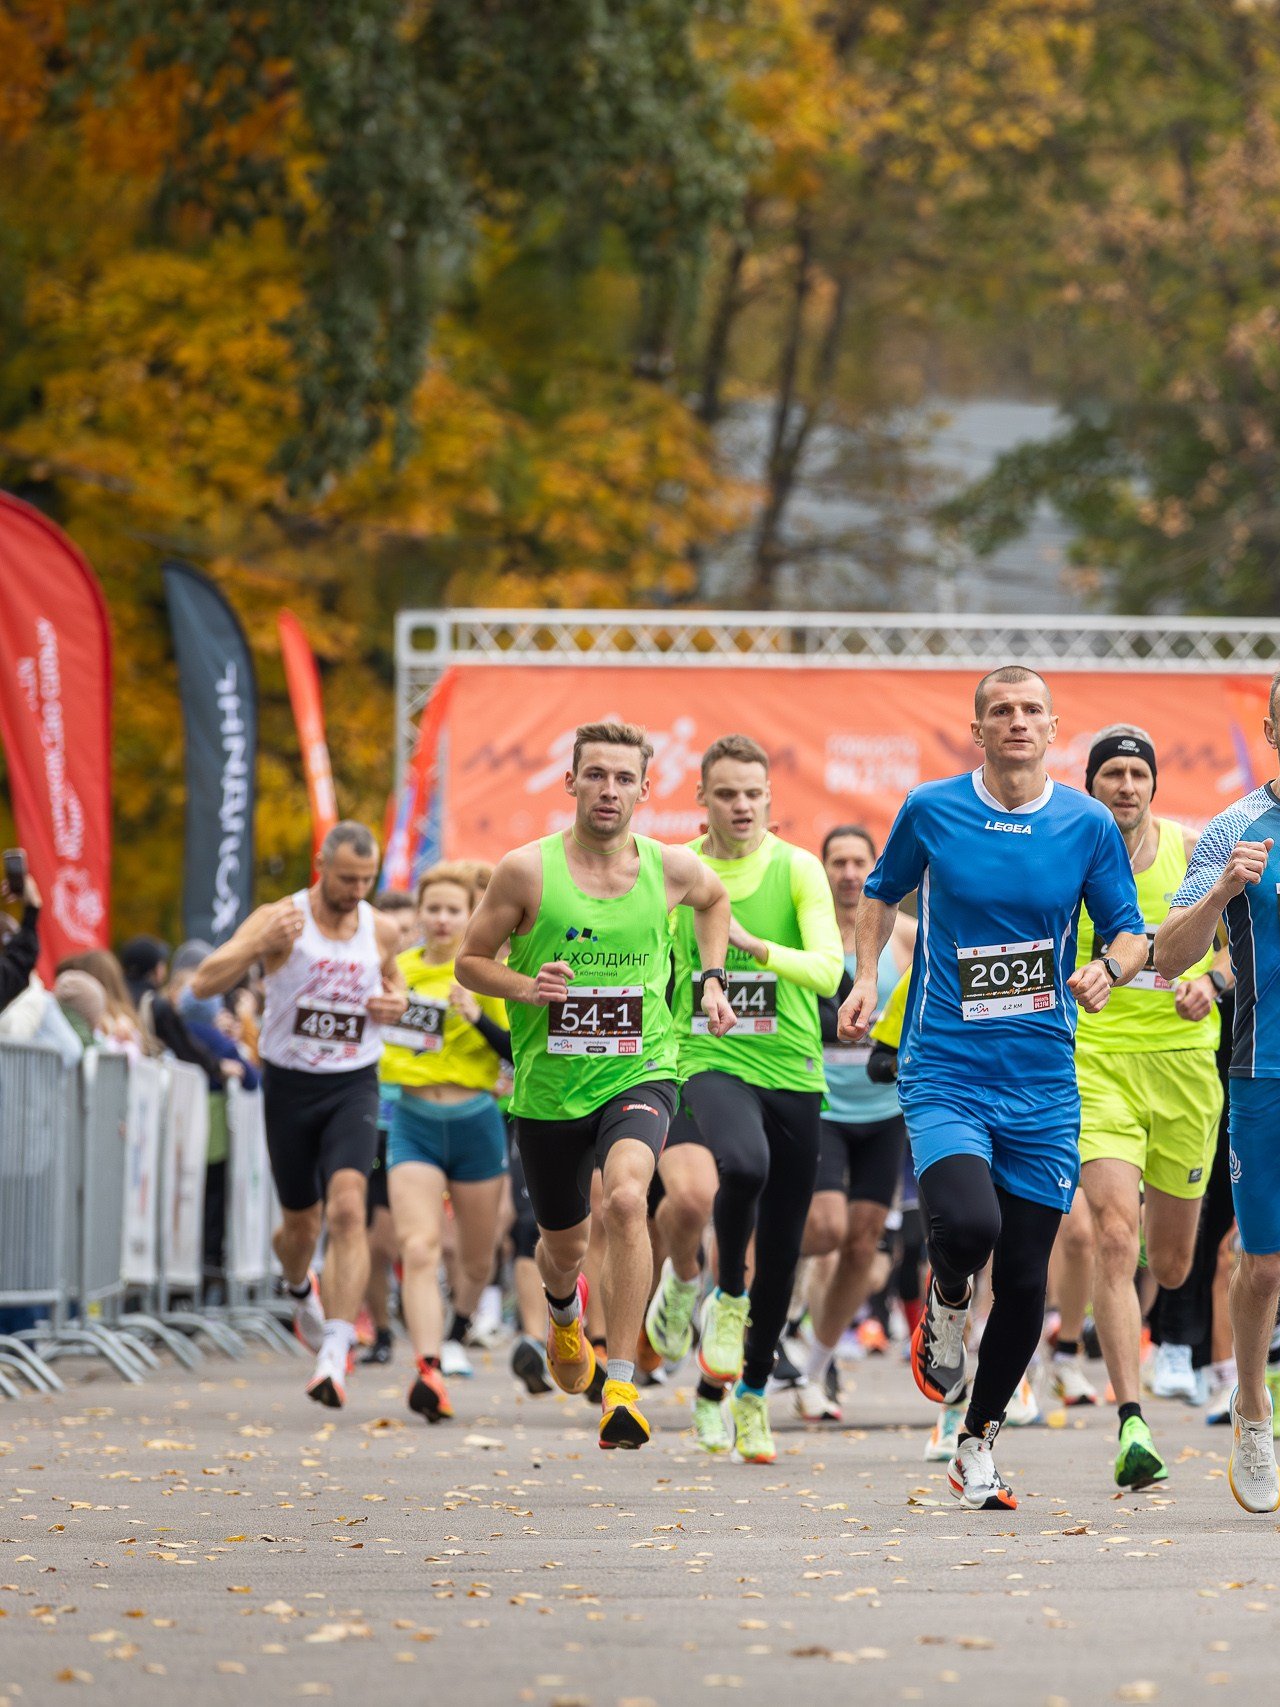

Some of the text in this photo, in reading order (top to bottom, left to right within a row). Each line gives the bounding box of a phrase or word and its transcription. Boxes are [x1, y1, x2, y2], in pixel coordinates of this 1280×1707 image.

[984, 820, 1032, 835] LEGEA
[553, 951, 650, 968] К-ХОЛДИНГ
[970, 957, 1046, 988] 2034
[301, 1011, 359, 1039] 49-1
[560, 1003, 632, 1032] 54-1
